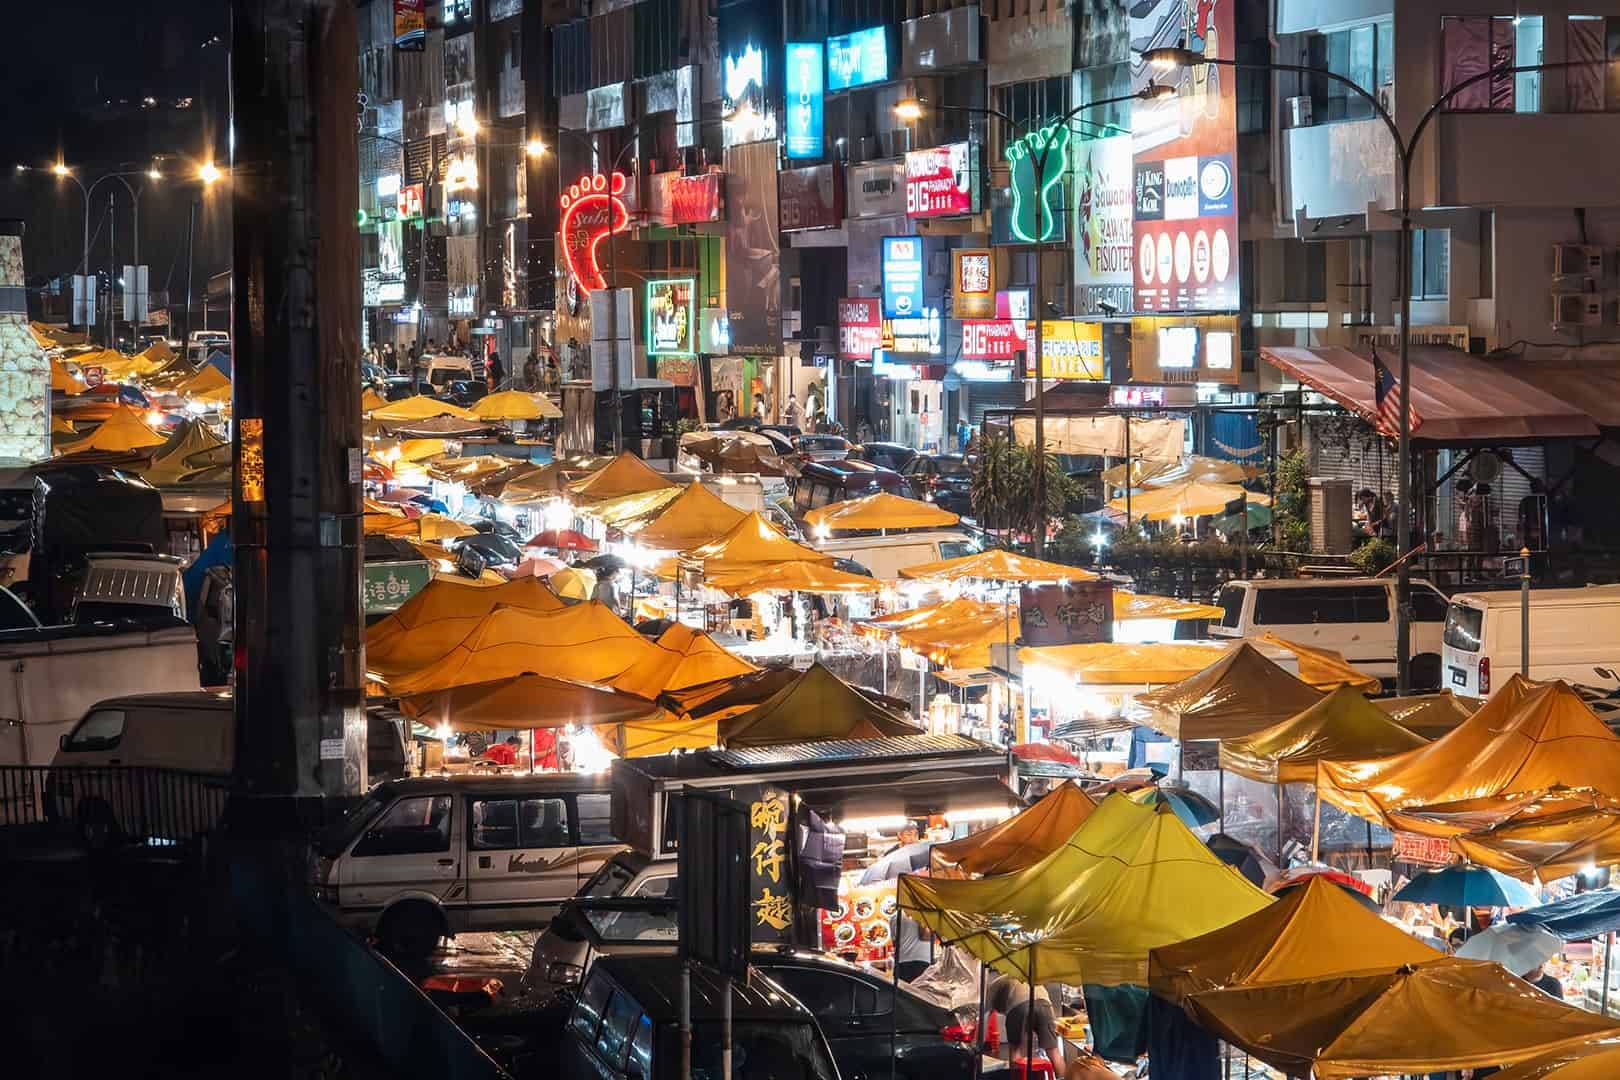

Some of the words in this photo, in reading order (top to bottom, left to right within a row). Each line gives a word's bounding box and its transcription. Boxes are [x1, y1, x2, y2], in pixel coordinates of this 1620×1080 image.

[907, 181, 929, 213] BIG
[781, 199, 801, 226] BIG
[840, 326, 861, 355] BIG
[963, 324, 987, 355] BIG
[815, 355, 825, 367] P
